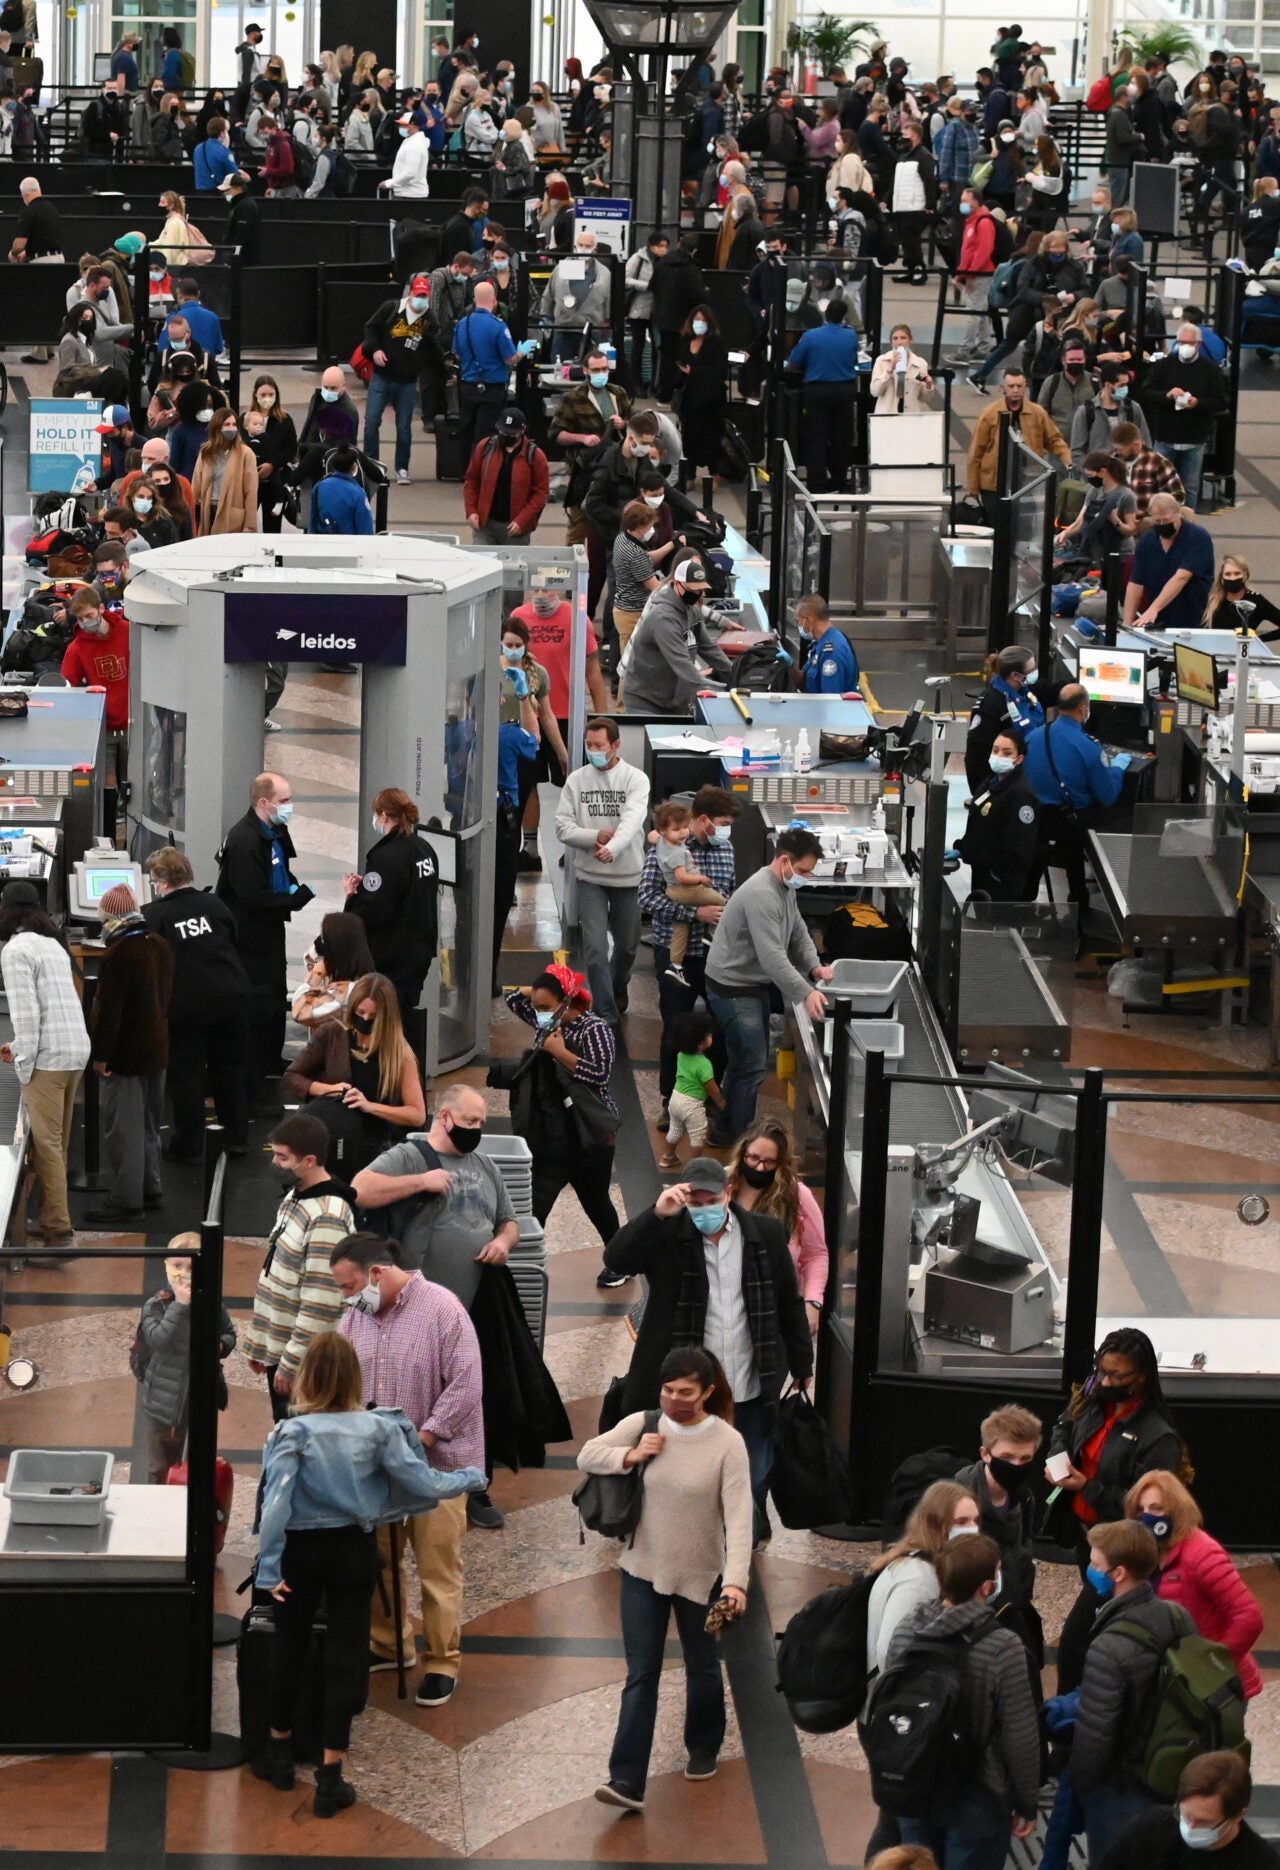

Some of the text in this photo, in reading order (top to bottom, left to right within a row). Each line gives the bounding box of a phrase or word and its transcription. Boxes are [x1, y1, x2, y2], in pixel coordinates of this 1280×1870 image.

[36, 415, 95, 426] EMPTY IT
[36, 428, 94, 439] HOLD IT
[36, 441, 94, 452] REFILL IT
[300, 632, 357, 650] leidos
[1241, 643, 1248, 658] 8
[936, 723, 945, 739] 7
[580, 791, 626, 804] GETTYSBURG
[588, 804, 621, 817] COLLEGE
[415, 857, 435, 879] TSA
[174, 916, 213, 940] TSA
